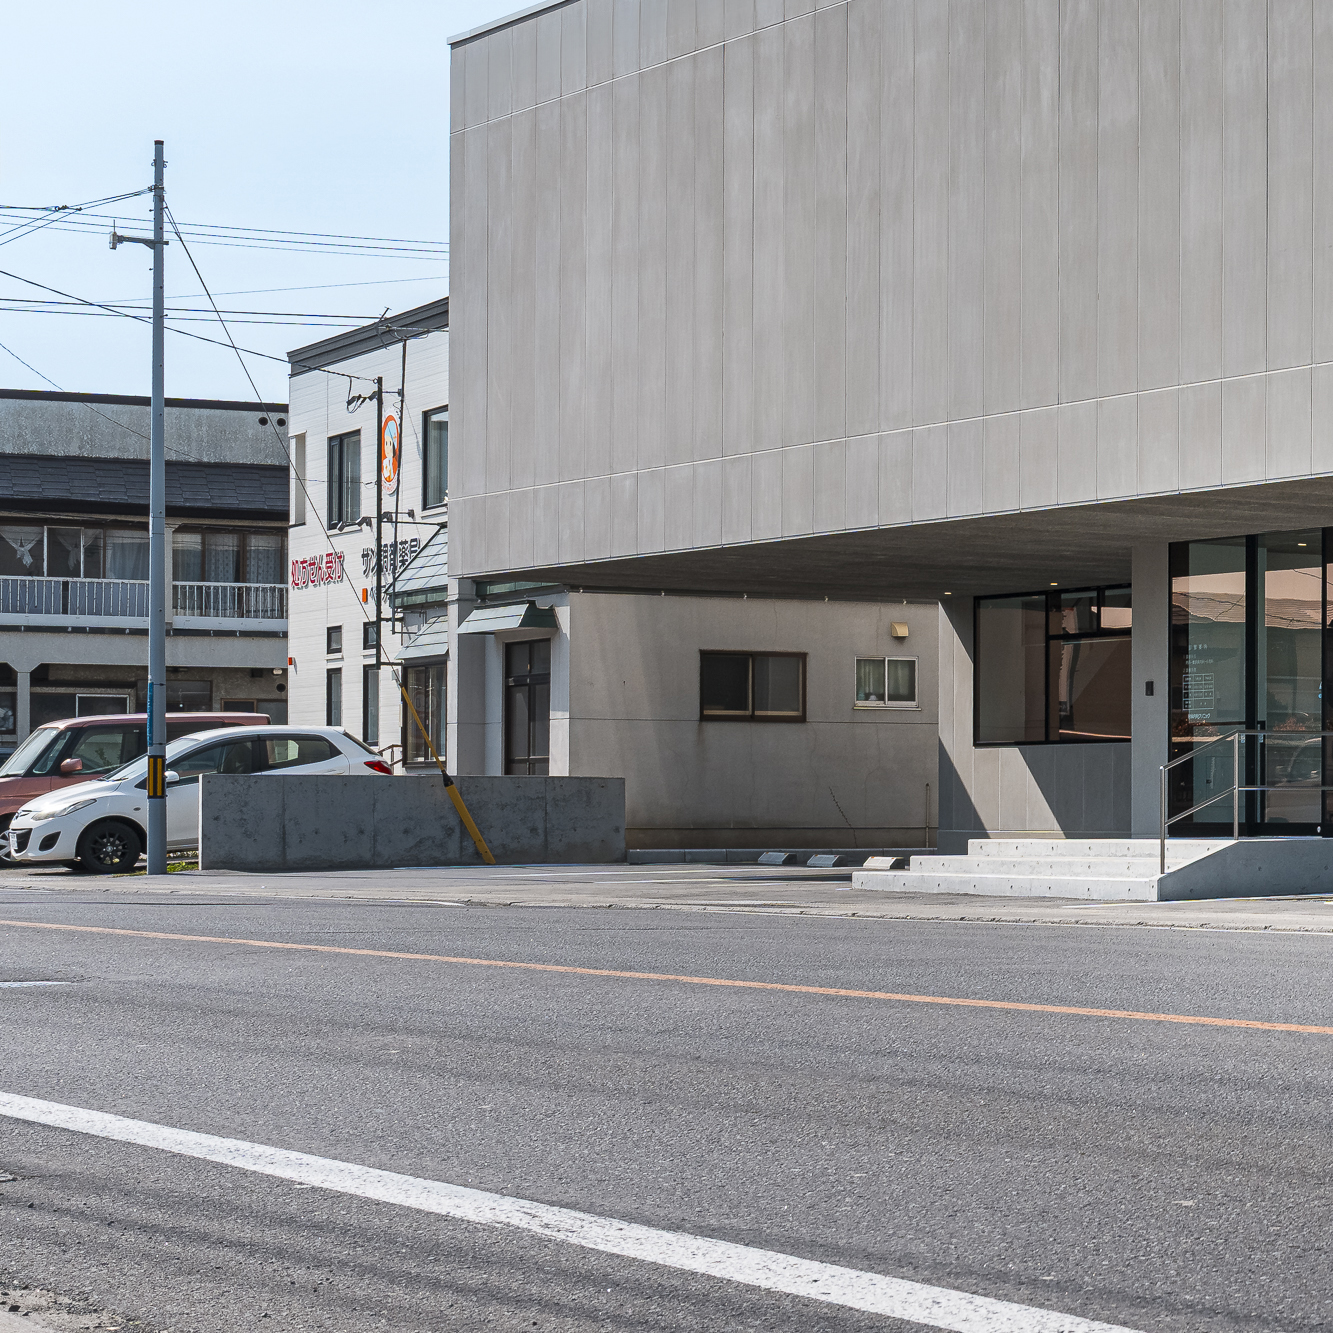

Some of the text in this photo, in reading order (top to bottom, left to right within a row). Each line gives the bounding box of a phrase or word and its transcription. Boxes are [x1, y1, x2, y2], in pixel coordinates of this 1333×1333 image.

[291, 551, 343, 587] 処方せん受付
